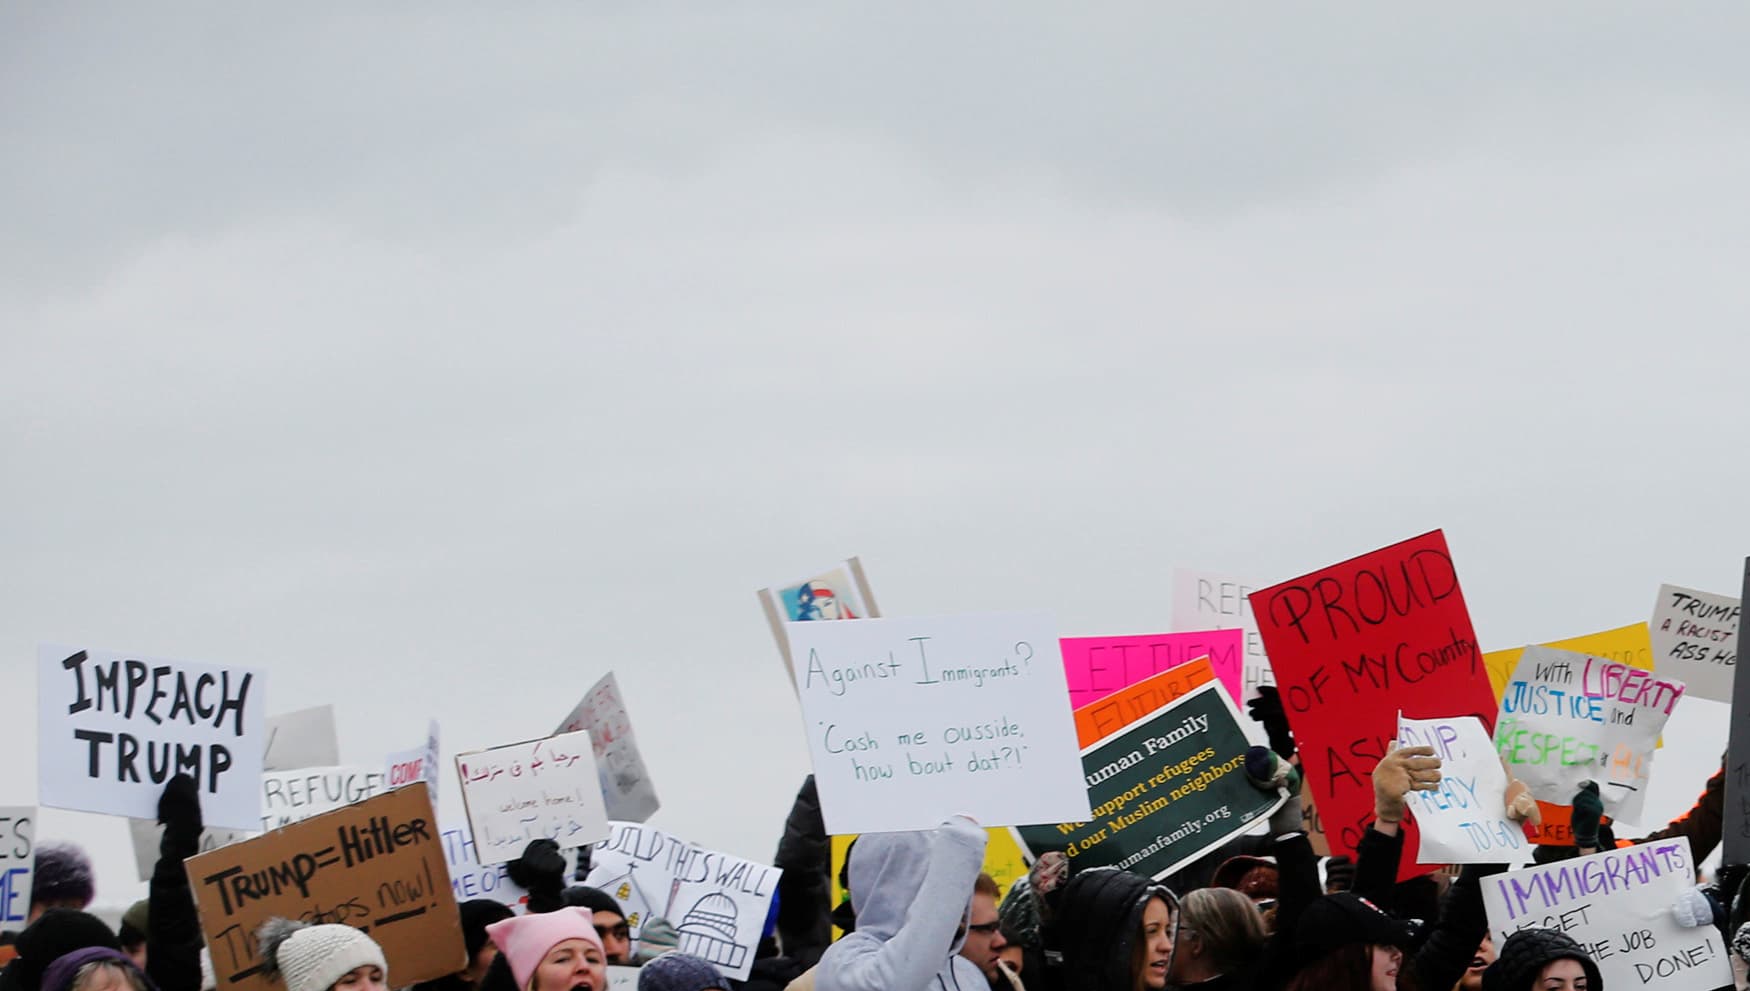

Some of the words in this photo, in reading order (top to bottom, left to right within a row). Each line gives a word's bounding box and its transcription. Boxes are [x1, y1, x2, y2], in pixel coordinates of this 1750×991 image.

[1268, 549, 1458, 645] PROUD
[1660, 618, 1672, 632] A
[1676, 619, 1734, 643] RACIST
[1668, 641, 1711, 661] ASS
[62, 650, 253, 736] IMPEACH
[806, 646, 902, 697] Against
[908, 635, 1034, 688] Immigrants?
[1287, 665, 1330, 713] OF
[1341, 653, 1391, 693] MY
[1394, 626, 1478, 684] Country
[1534, 661, 1574, 685] With
[1581, 657, 1687, 716] LIBERTY
[897, 731, 928, 746] me
[1494, 718, 1601, 767] RESPECT
[1610, 707, 1635, 727] and
[74, 729, 232, 793] TRUMP
[850, 757, 894, 783] how
[908, 751, 954, 777] bout
[1087, 749, 1143, 787] uman
[1142, 713, 1209, 756] Family
[1148, 746, 1216, 789] refugees
[1079, 828, 1109, 850] our
[1107, 796, 1170, 834] Muslim
[1170, 753, 1246, 803] neighbors
[376, 855, 438, 908] now!
[666, 836, 715, 884] THIS
[714, 856, 770, 897] WALL
[1497, 843, 1692, 921] IMMIGRANTS,
[1619, 928, 1657, 955] JOB
[1633, 938, 1716, 985] DONE!
